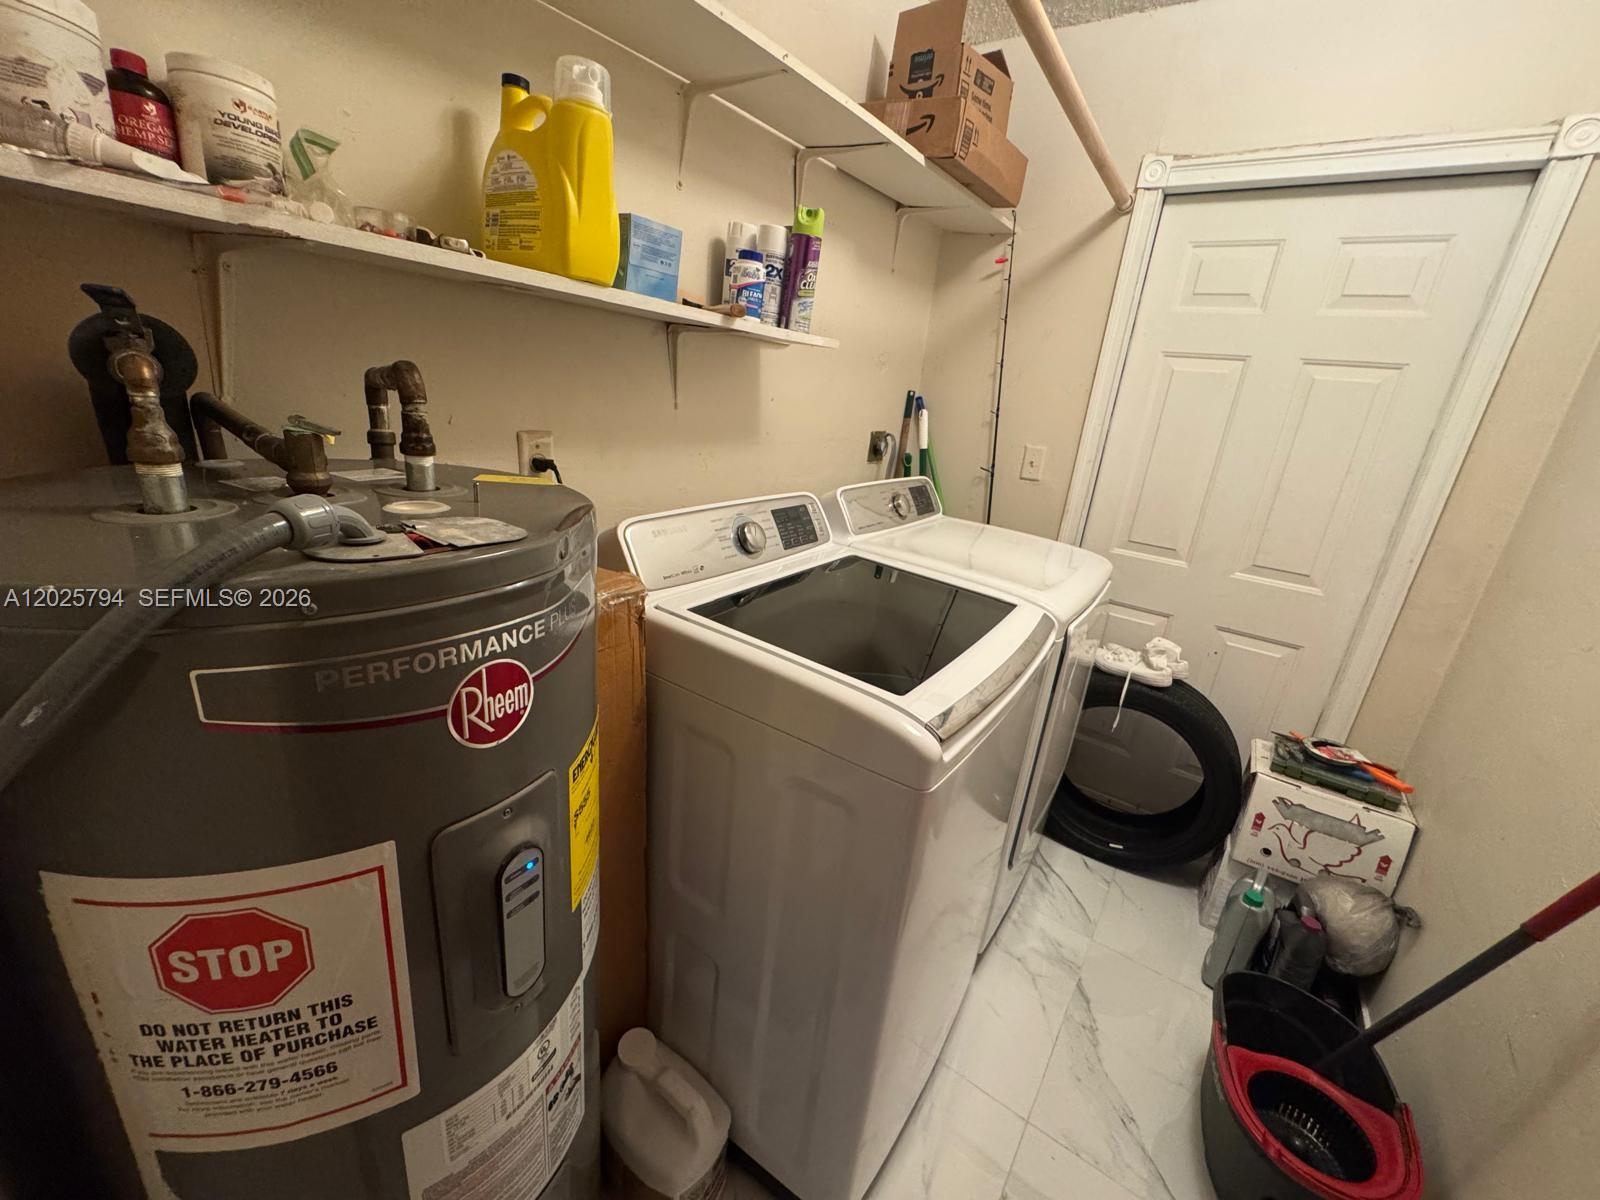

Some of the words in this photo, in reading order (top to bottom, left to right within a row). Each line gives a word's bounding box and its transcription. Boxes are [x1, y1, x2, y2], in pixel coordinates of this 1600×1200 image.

[118, 113, 176, 138] OREGAN
[217, 109, 264, 130] YOUNG
[765, 263, 783, 280] 2X
[314, 618, 546, 693] PERFORMANCE
[460, 668, 529, 739] Rheem
[167, 938, 294, 984] STOP
[139, 1023, 166, 1038] DO
[172, 1021, 212, 1037] NOT
[219, 1007, 302, 1034] RETURN
[307, 994, 354, 1018] THIS
[156, 1036, 226, 1054] WATER
[232, 1021, 312, 1048] HEATER
[318, 1012, 343, 1031] TO
[128, 1053, 166, 1069] THE
[171, 1046, 235, 1069] PLACE
[240, 1047, 267, 1063] OF
[273, 1016, 379, 1057] PURCHASE
[180, 1061, 339, 1099] 1-866-279-4566
